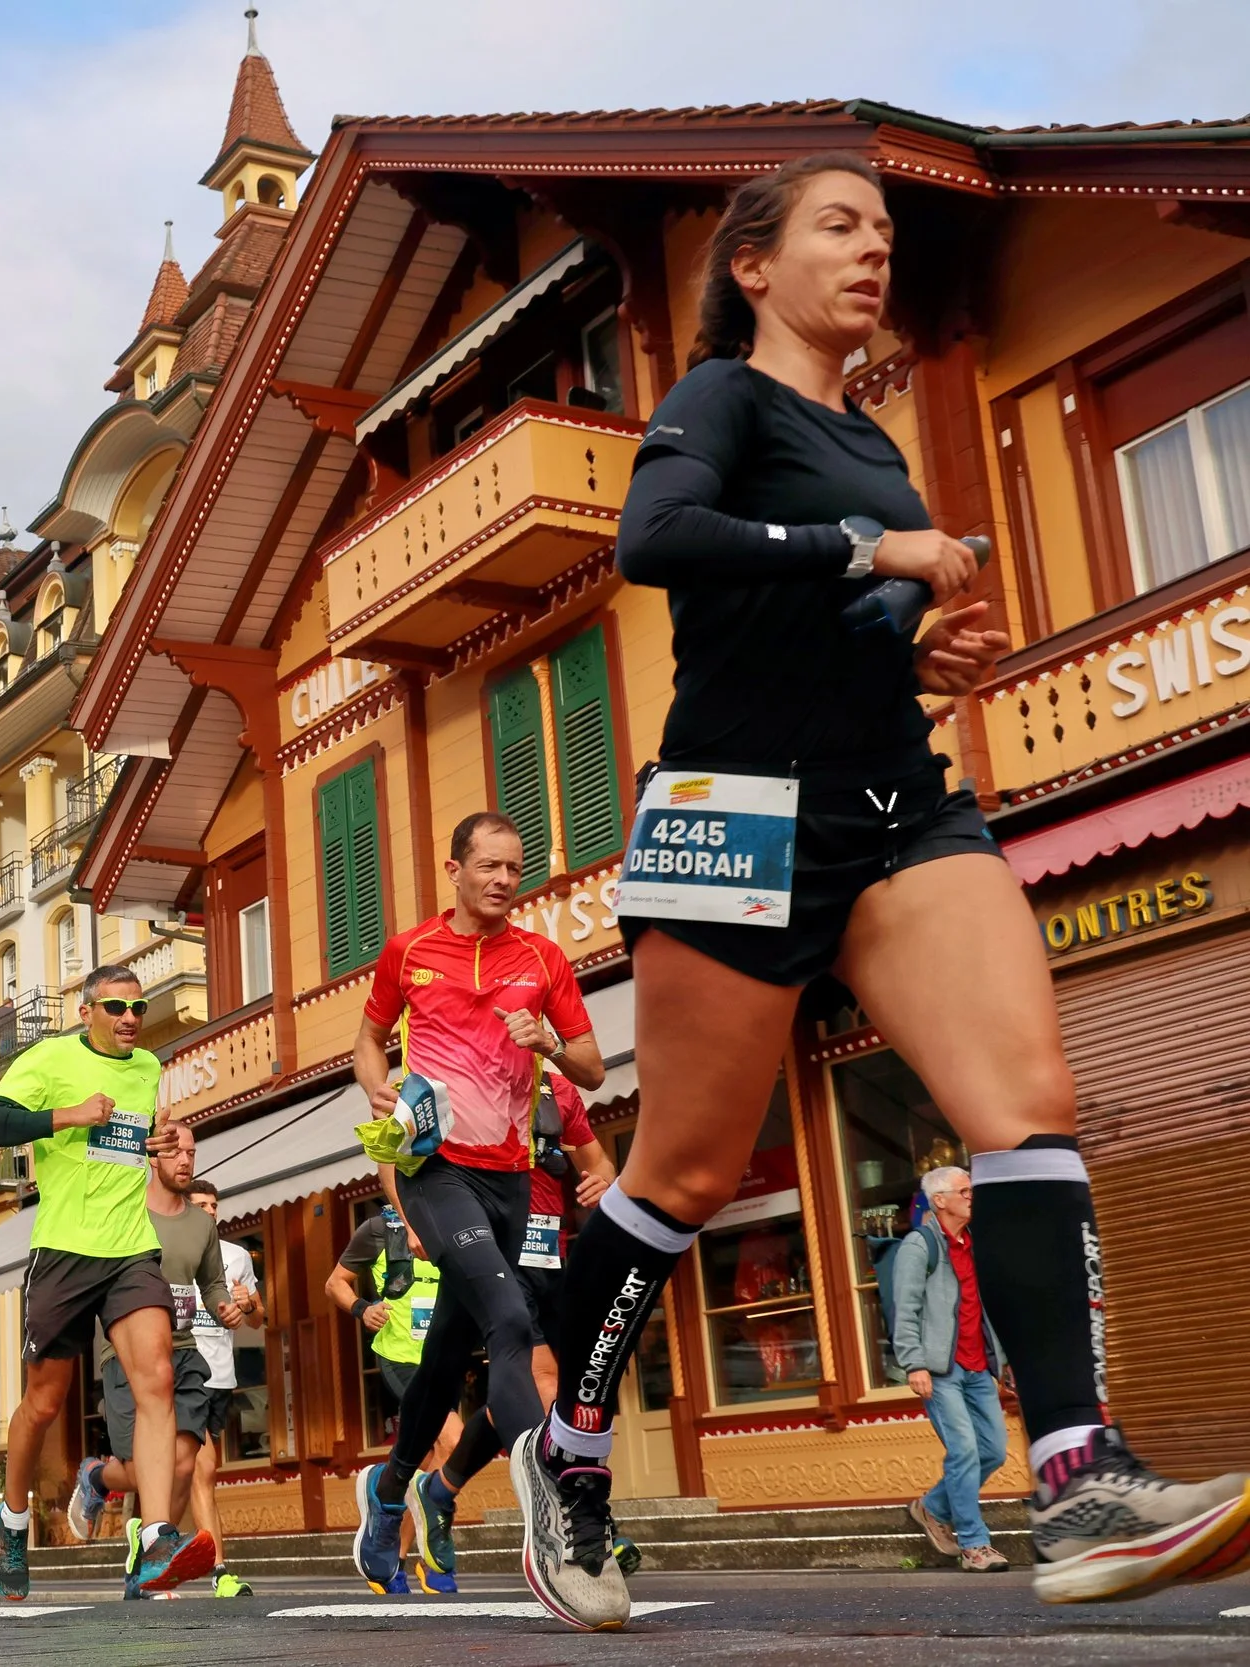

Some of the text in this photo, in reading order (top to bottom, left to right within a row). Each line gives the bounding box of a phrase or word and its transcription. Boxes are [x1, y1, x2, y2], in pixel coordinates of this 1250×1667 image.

[1107, 606, 1250, 718] SWIS
[292, 658, 391, 727] CHALE
[651, 819, 726, 847] 4245
[630, 849, 754, 879] DEBORAH
[1043, 871, 1213, 949] ONTRES
[415, 970, 428, 980] 20
[110, 1112, 134, 1122] RAFT
[423, 1096, 436, 1129] MANI
[99, 1135, 141, 1151] FEDERICO
[111, 1126, 133, 1138] 1368
[526, 1230, 542, 1240] 274
